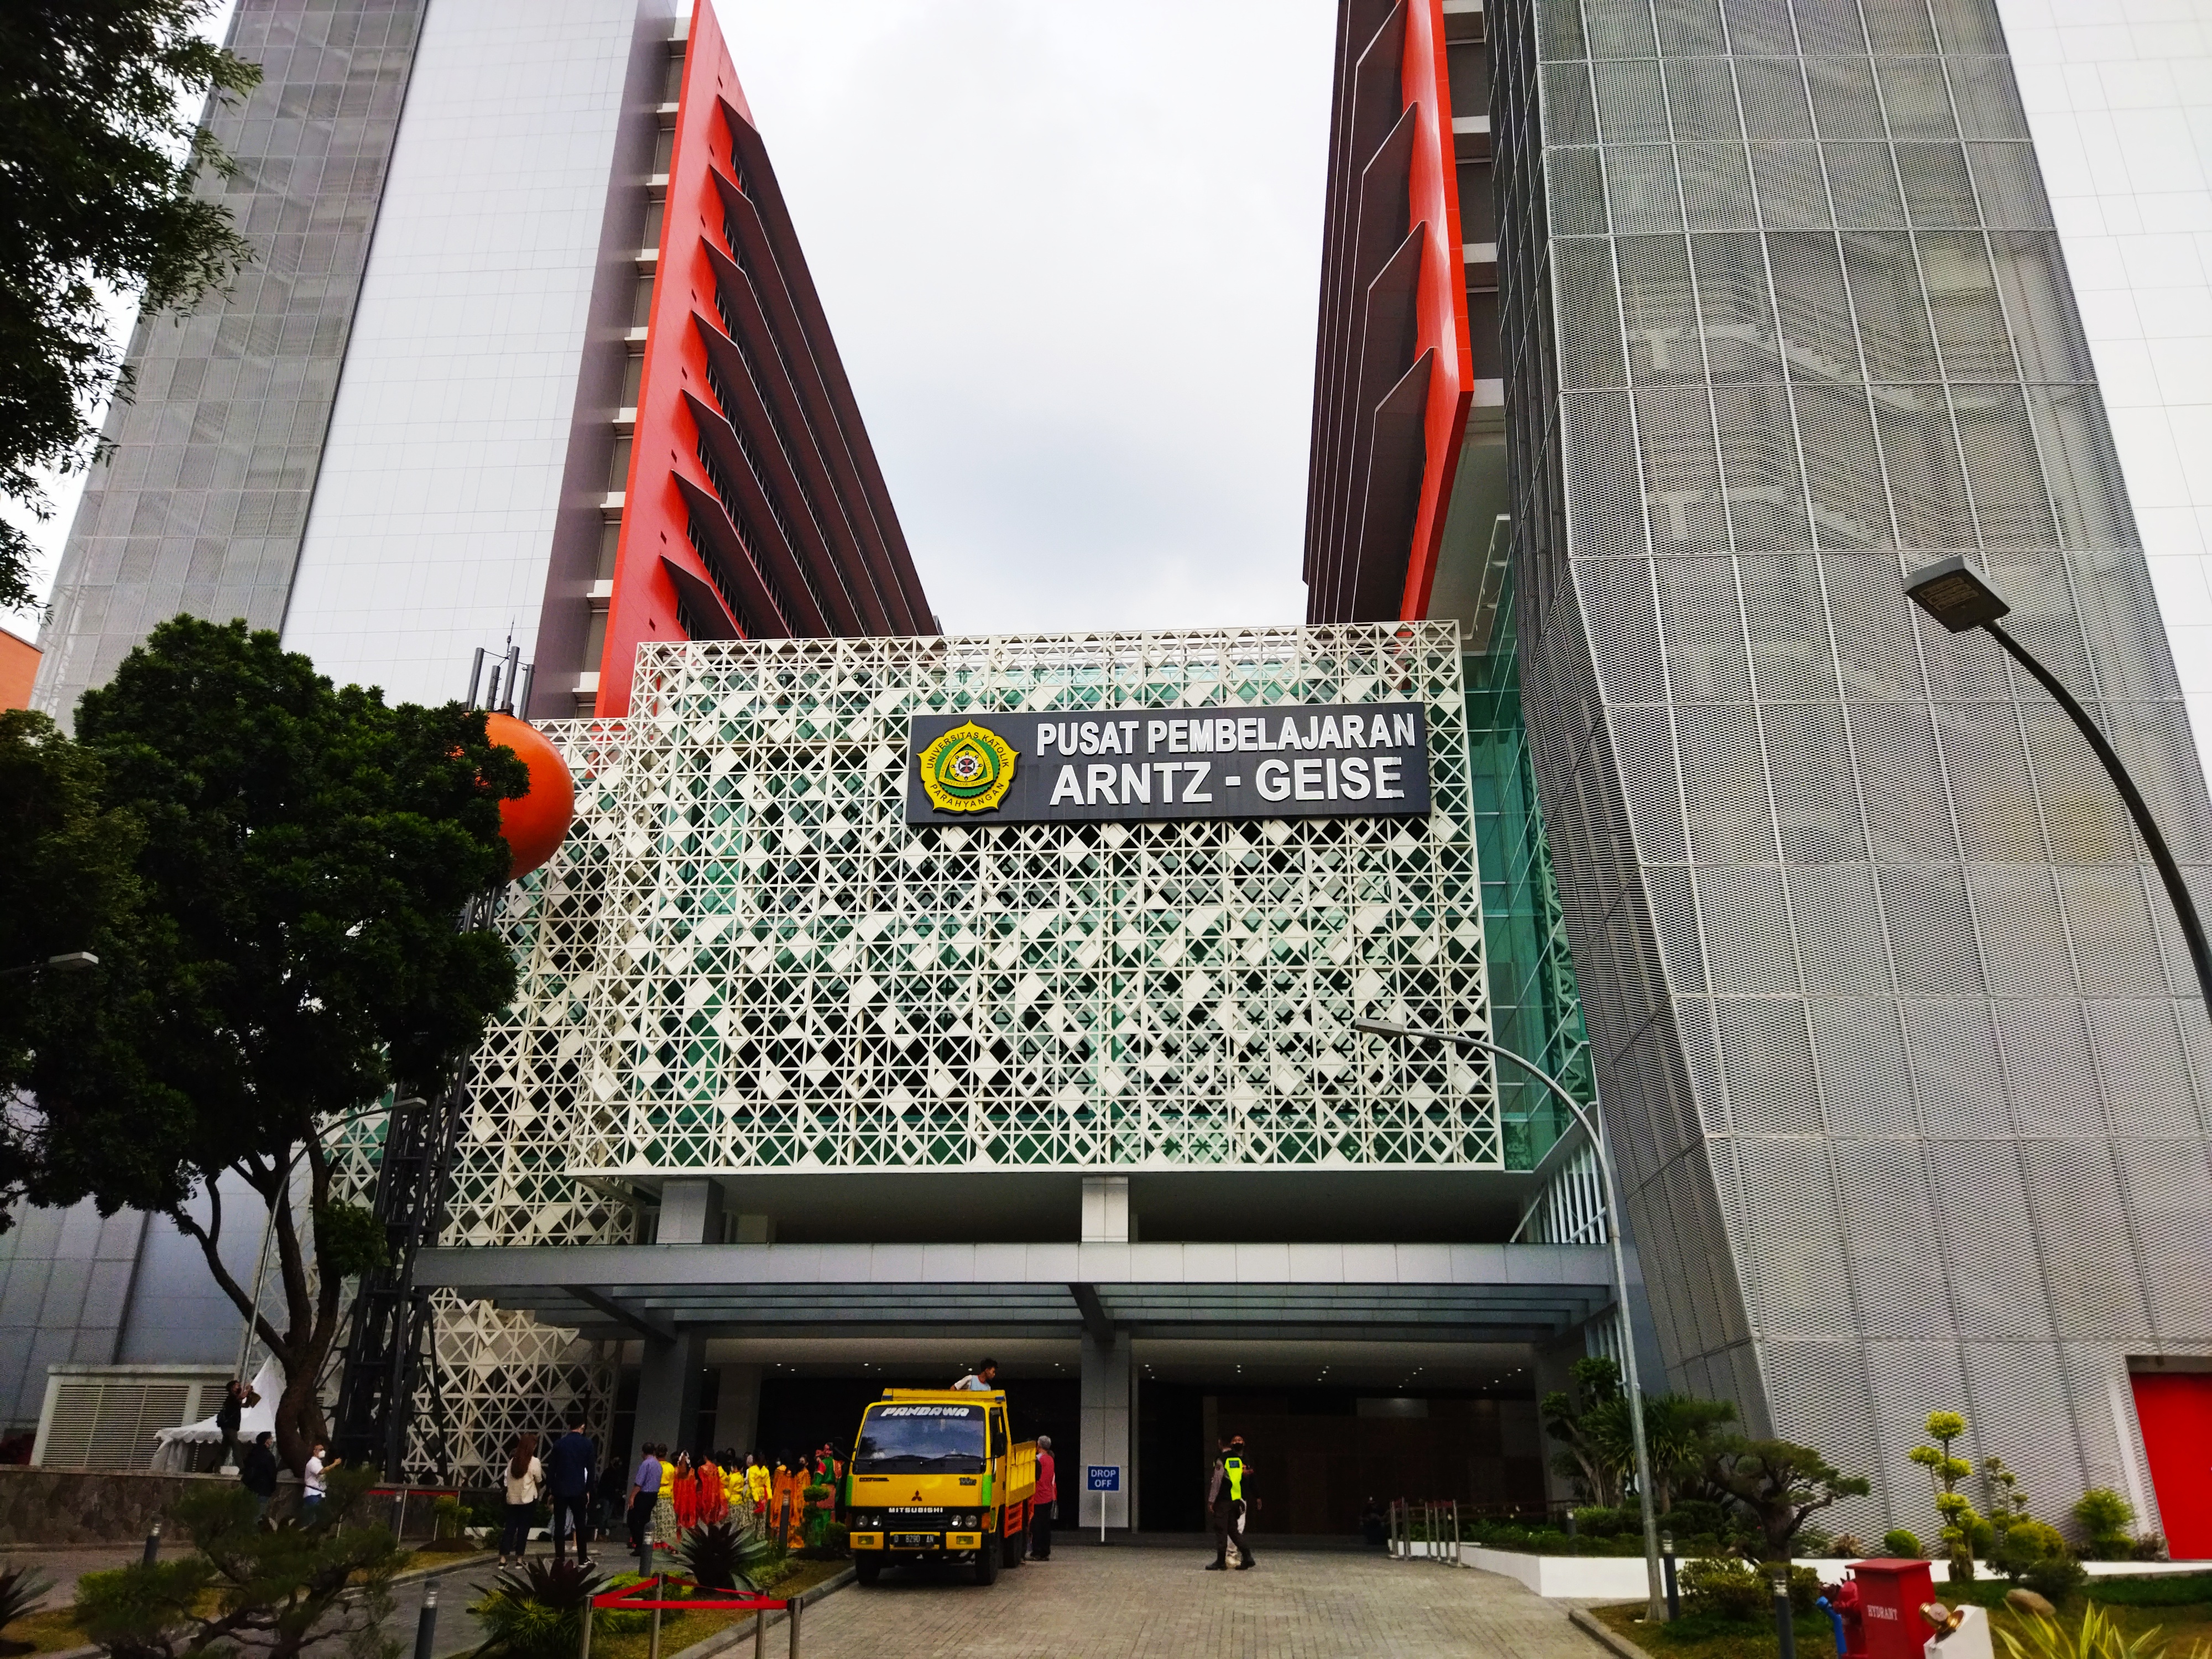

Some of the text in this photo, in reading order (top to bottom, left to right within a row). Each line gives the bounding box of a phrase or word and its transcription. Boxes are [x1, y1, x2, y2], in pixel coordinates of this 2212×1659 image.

[1037, 713, 1415, 756] PUSAT PEMBELAJARAN
[926, 732, 1009, 769] UNIVERSITAS KATOLIK
[1049, 757, 1405, 805] ARNTZ - GEISE
[930, 782, 1004, 808] PARAHYANGAN
[880, 1406, 969, 1417] PANDAWA
[1095, 1479, 1112, 1488] OFF
[1867, 1605, 1897, 1620] HYDRANT
